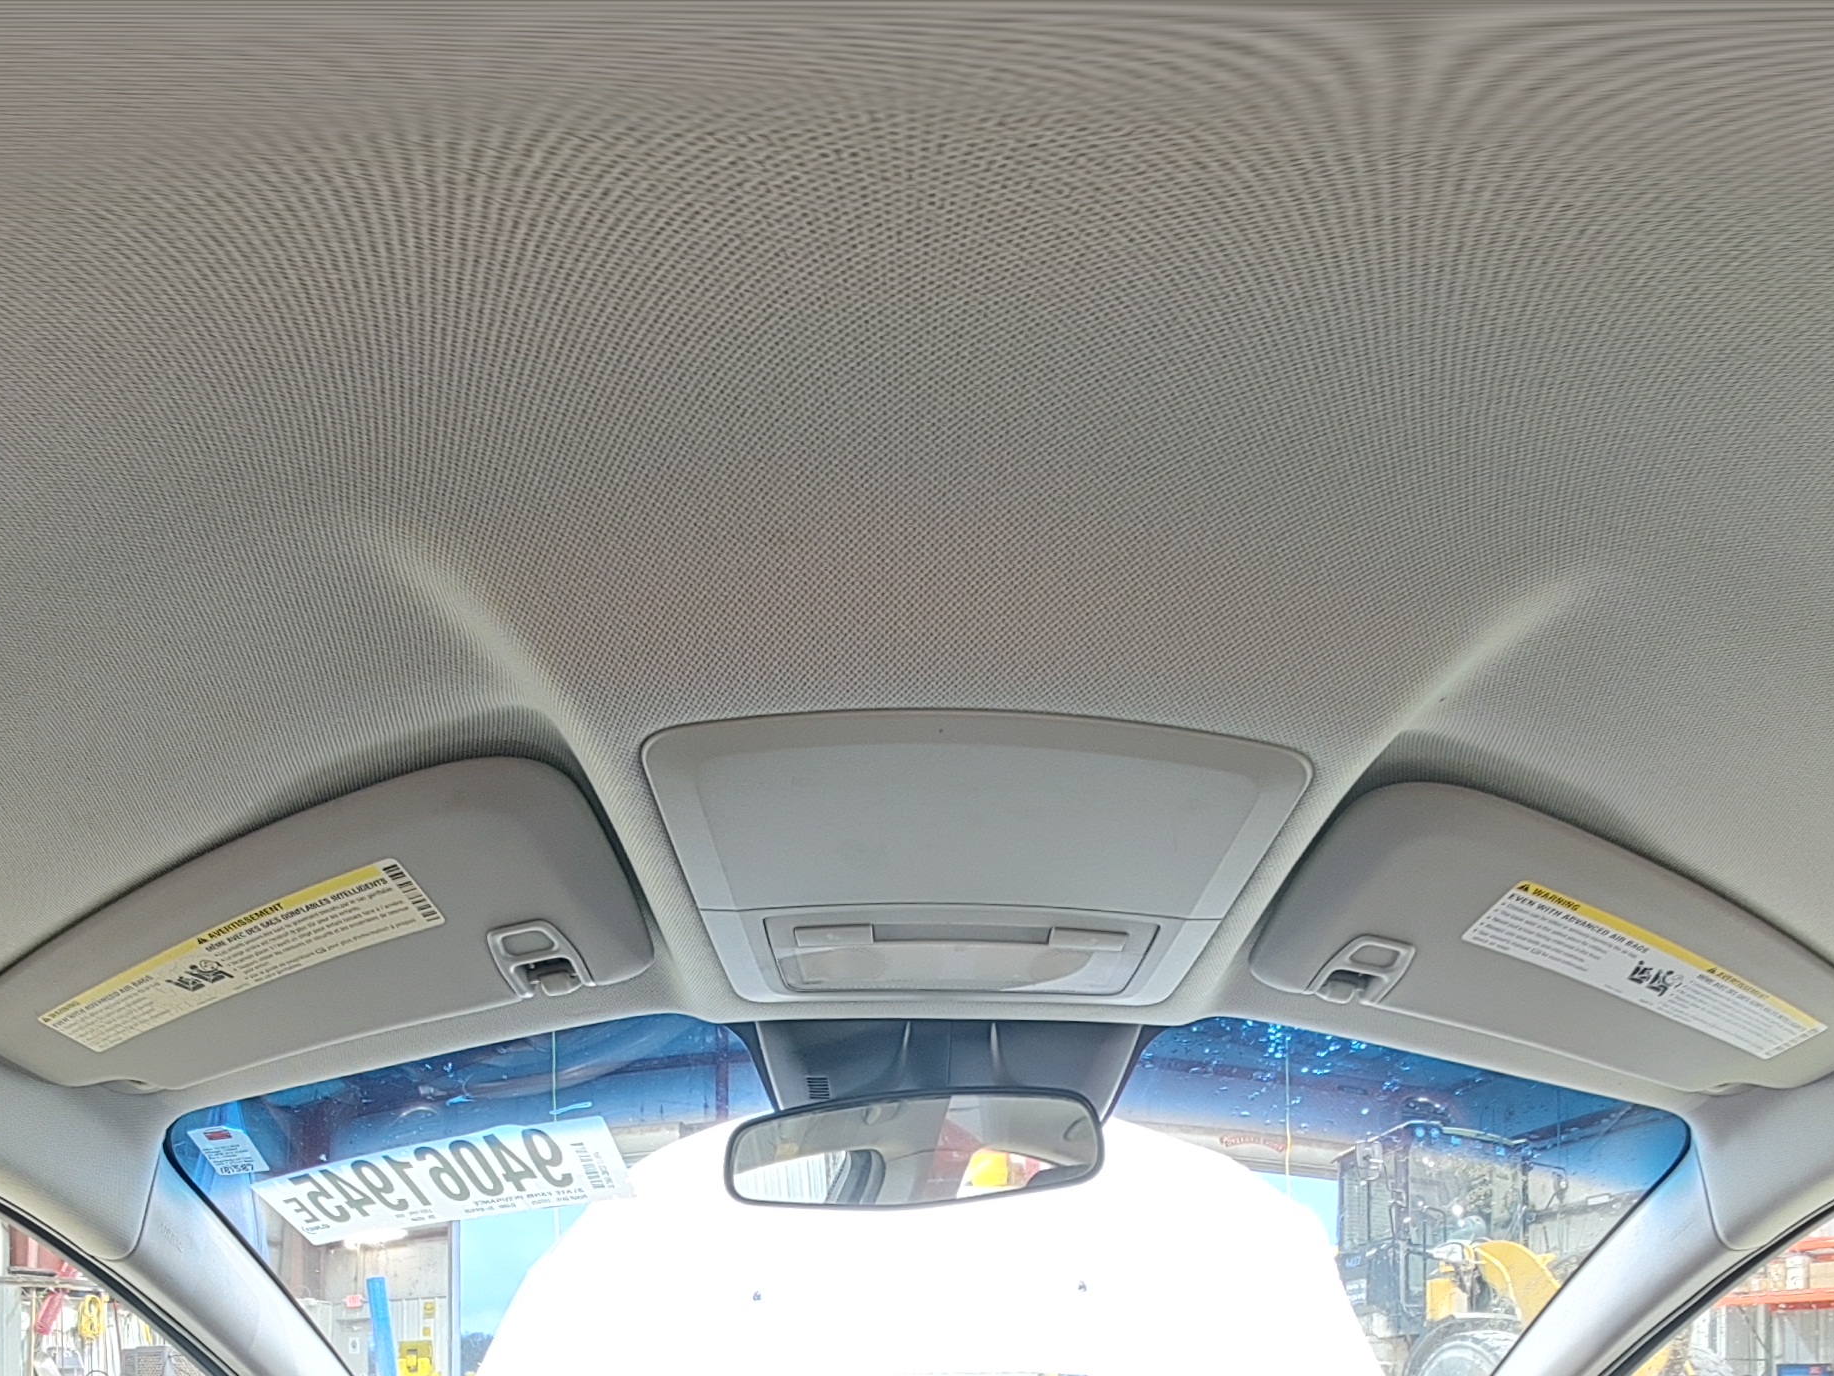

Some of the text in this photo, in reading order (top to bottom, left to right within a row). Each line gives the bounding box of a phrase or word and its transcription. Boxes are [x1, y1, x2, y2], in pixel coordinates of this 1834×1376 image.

[1532, 888, 1581, 912] WARNING
[207, 902, 284, 939] AVERTISSEMENT
[1507, 893, 1650, 954] EVEN WITH ADVANCED AIR BAGS
[227, 933, 246, 947] AVEC
[246, 927, 261, 939] DES
[1717, 971, 1770, 1001] AVERTISSEMENT
